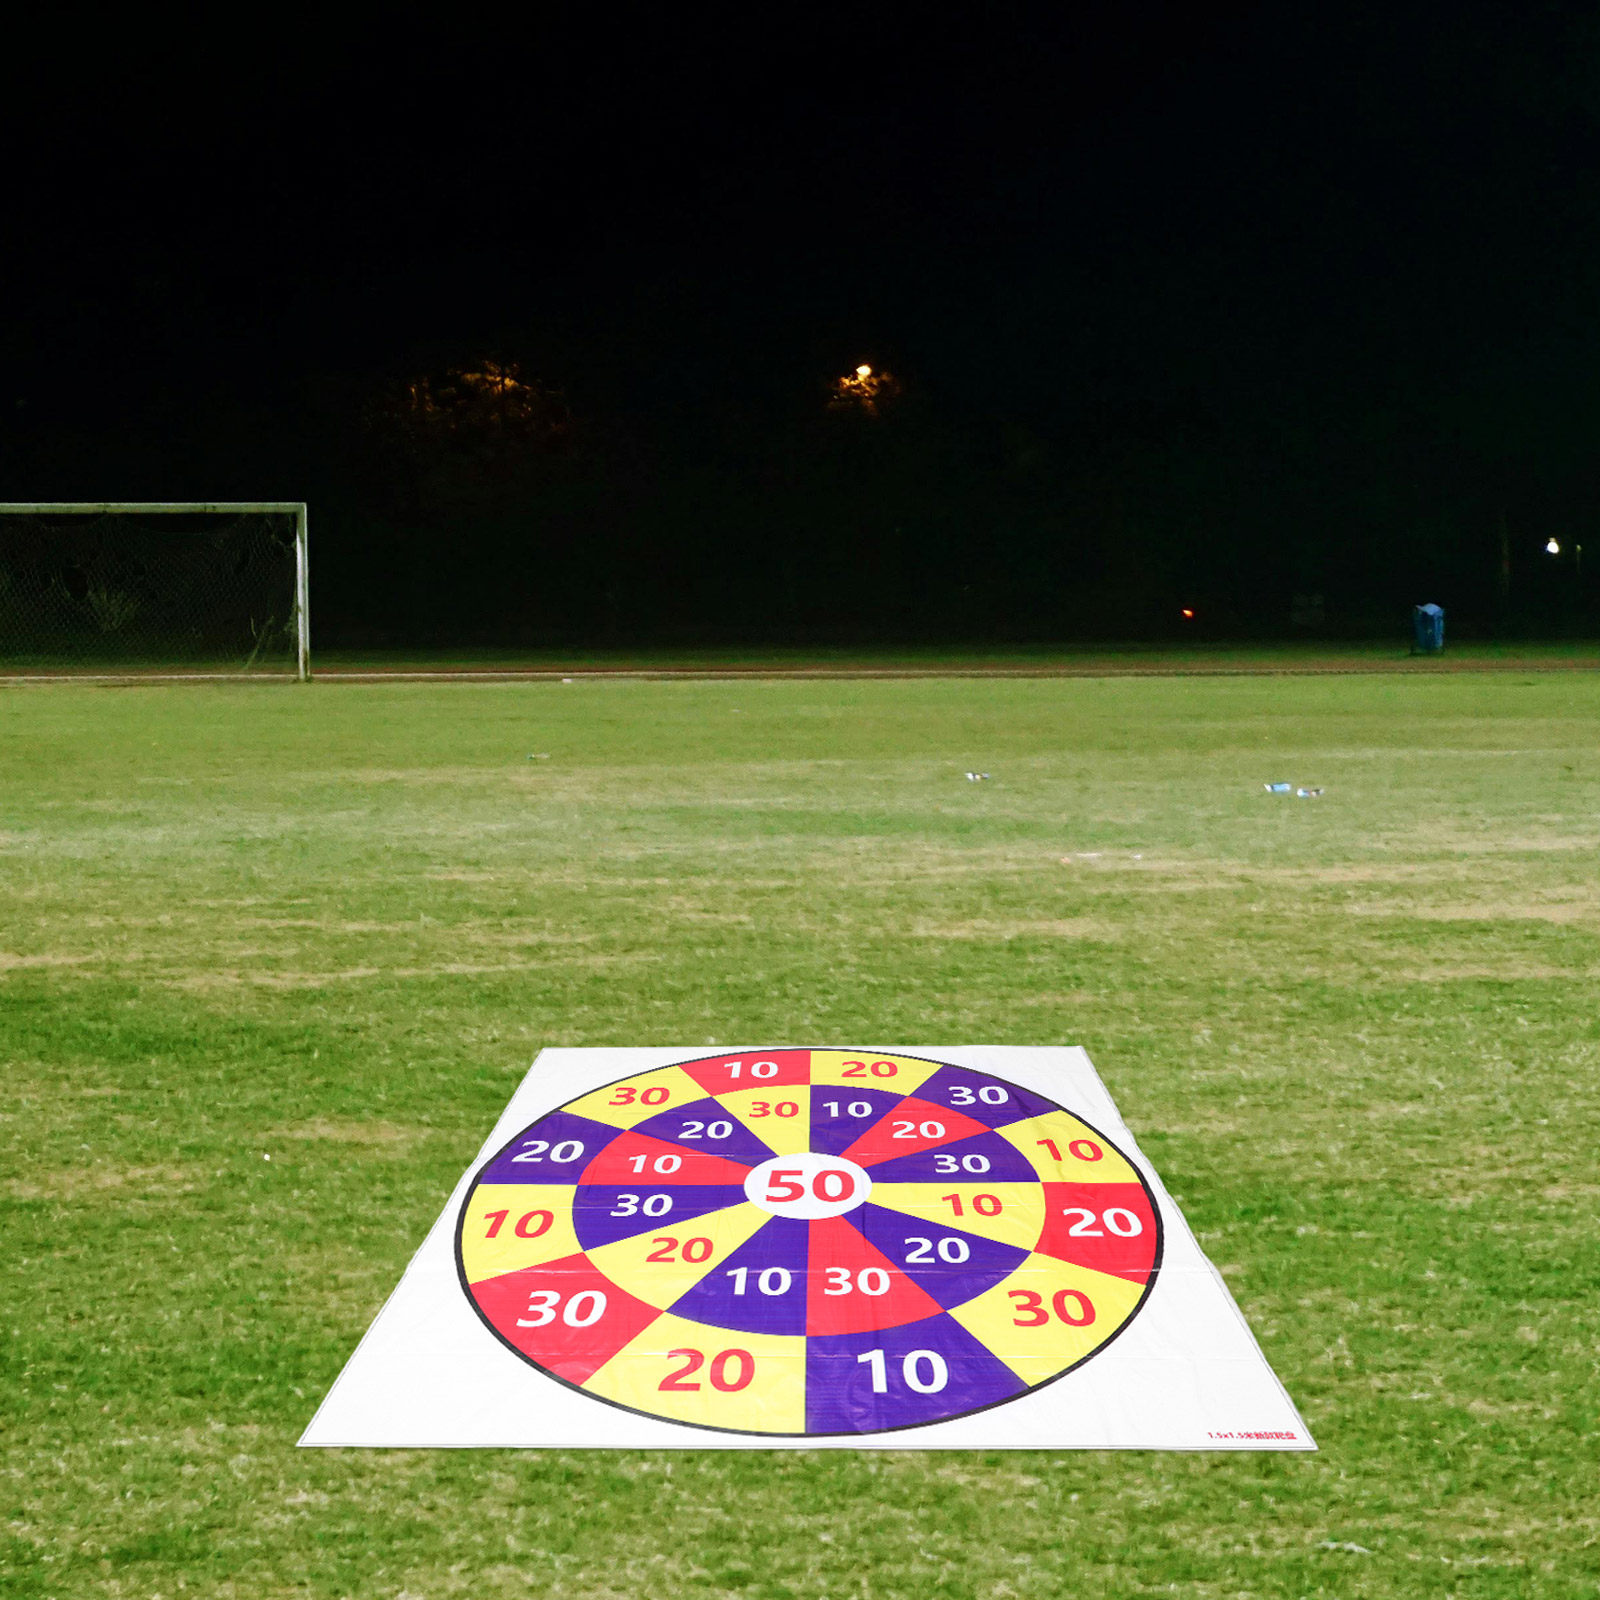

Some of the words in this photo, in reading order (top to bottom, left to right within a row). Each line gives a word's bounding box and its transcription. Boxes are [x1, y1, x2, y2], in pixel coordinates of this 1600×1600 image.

[724, 1062, 778, 1078] 10
[842, 1061, 897, 1077] 20
[609, 1088, 670, 1105] 30
[949, 1086, 1008, 1105] 30
[749, 1102, 798, 1117] 30
[823, 1102, 872, 1117] 10
[679, 1121, 733, 1139] 20
[893, 1121, 945, 1138] 20
[512, 1141, 584, 1162] 20
[1037, 1139, 1103, 1161] 10
[629, 1155, 681, 1173] 10
[934, 1155, 990, 1173] 30
[766, 1170, 854, 1202] 50
[610, 1194, 672, 1216] 30
[942, 1194, 1002, 1216] 10
[485, 1210, 554, 1238] 10
[1063, 1208, 1142, 1237] 20
[646, 1238, 713, 1263] 20
[905, 1238, 969, 1263] 20
[727, 1267, 794, 1295] 10
[822, 1267, 891, 1296] 30
[516, 1291, 606, 1327] 30
[1008, 1290, 1095, 1326] 30
[658, 1349, 754, 1392] 20
[858, 1349, 948, 1393] 10
